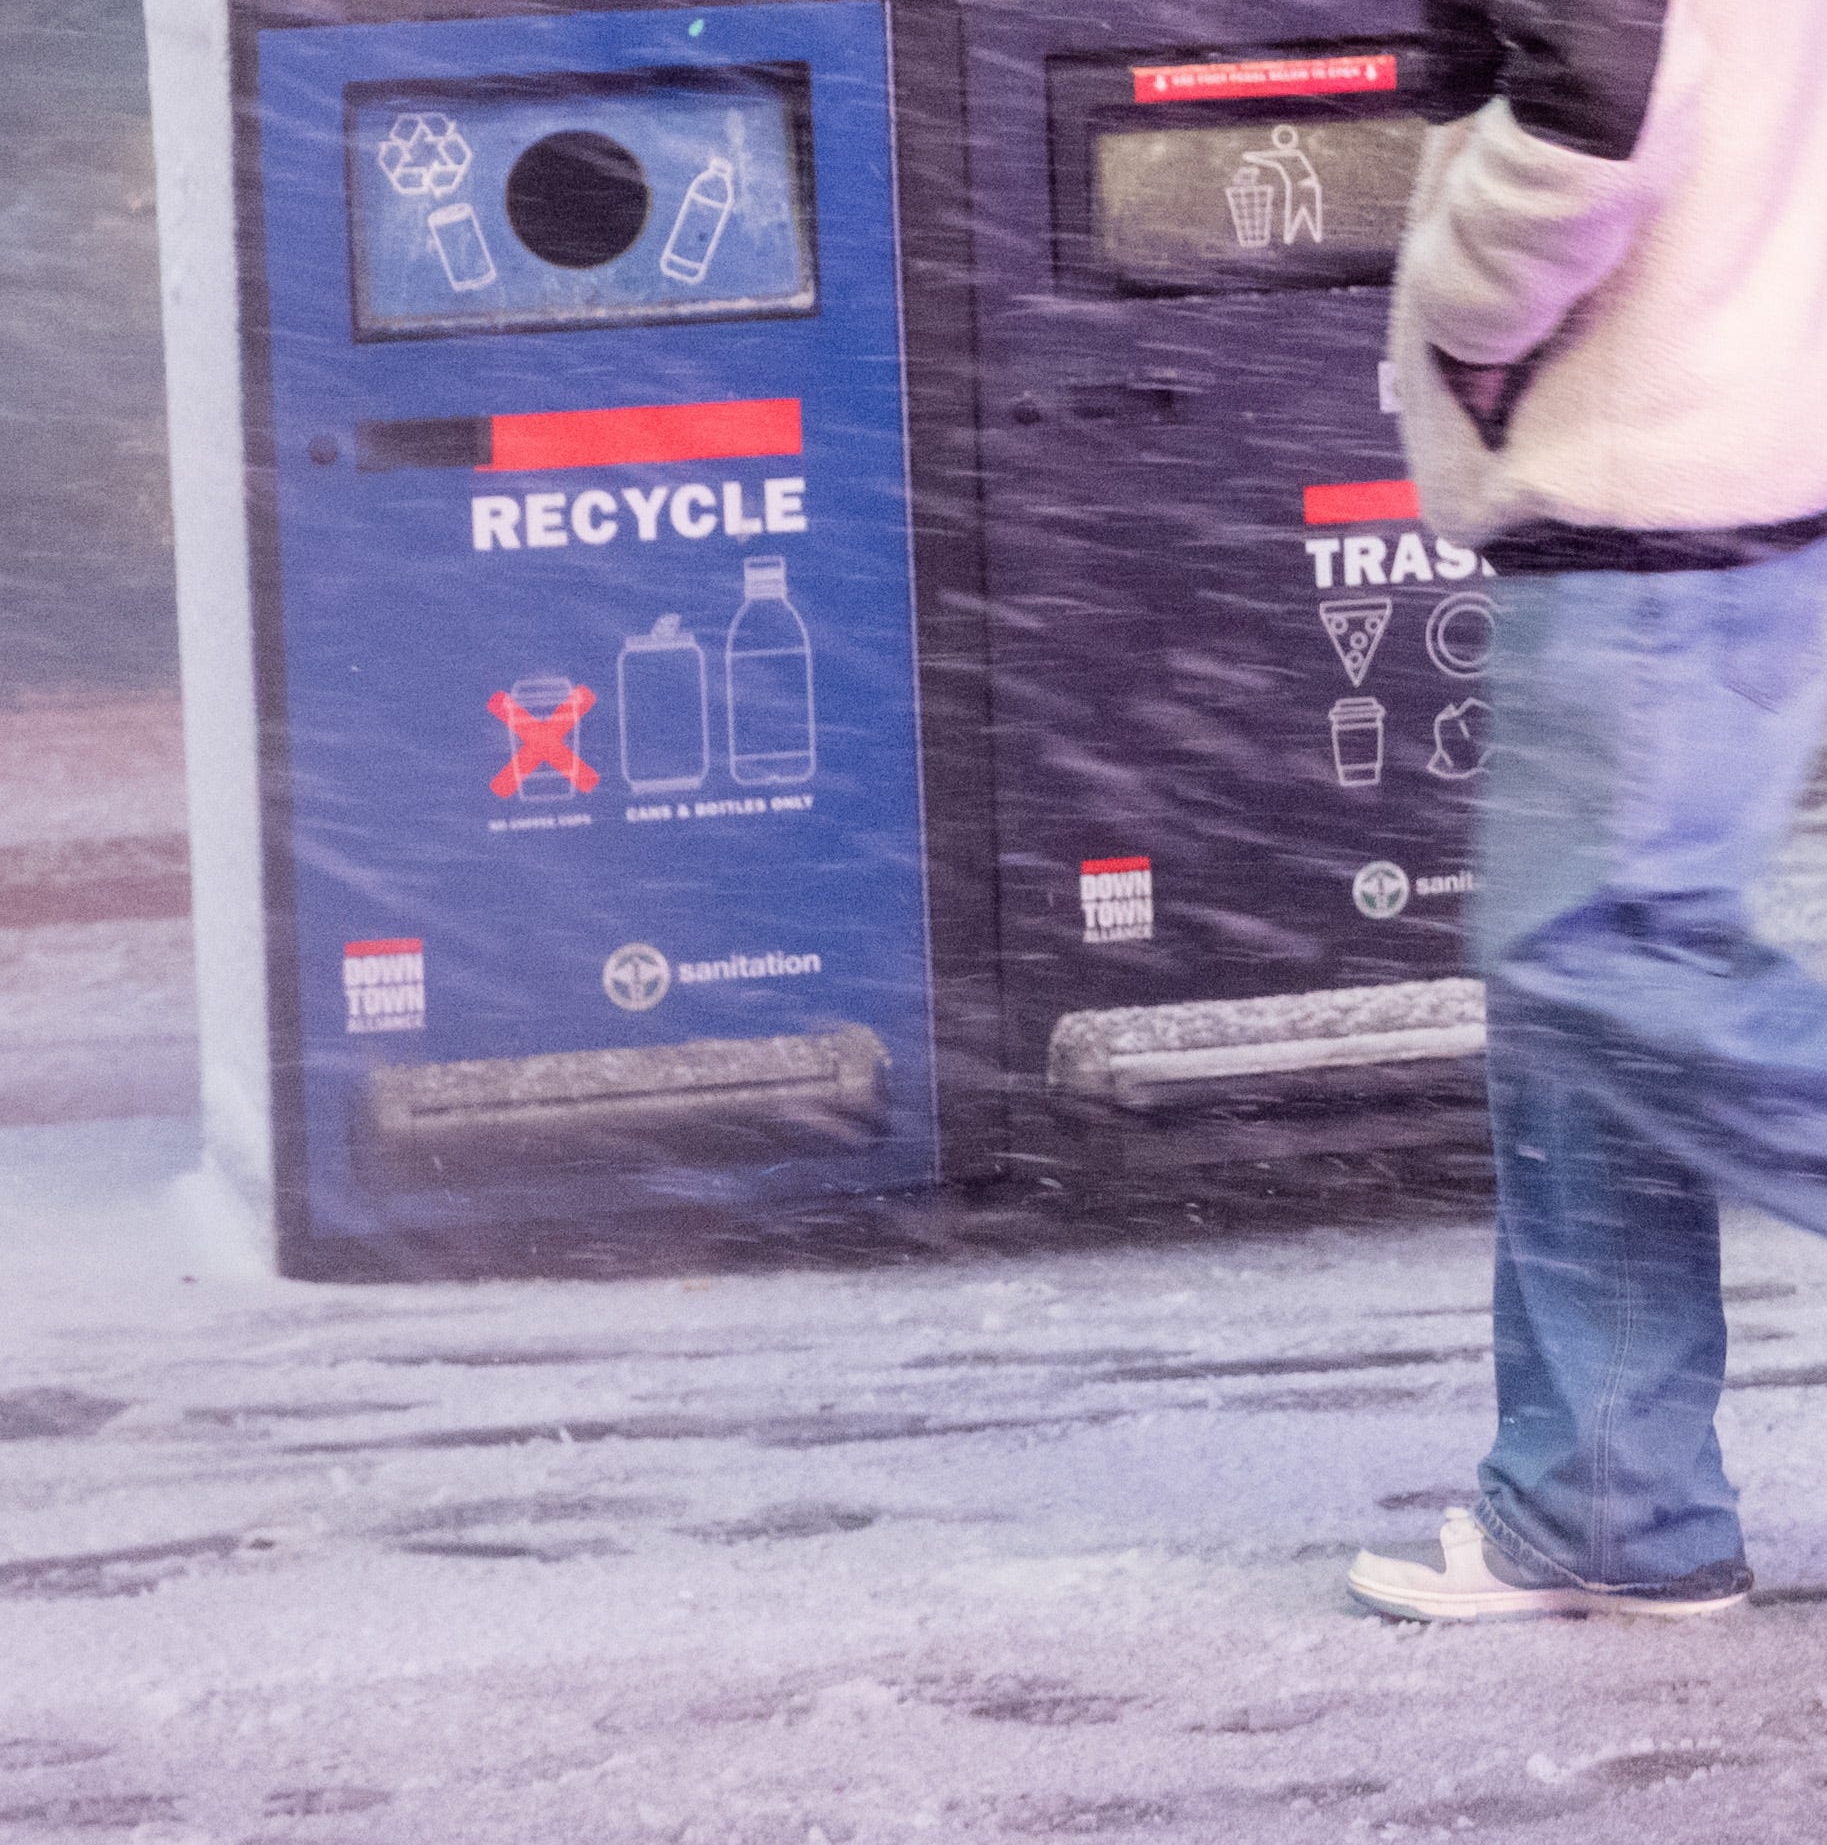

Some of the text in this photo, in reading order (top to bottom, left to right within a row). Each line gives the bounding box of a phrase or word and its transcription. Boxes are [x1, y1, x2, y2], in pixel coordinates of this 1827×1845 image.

[471, 476, 808, 551] RECYCLE
[625, 806, 672, 823] CANS
[694, 797, 767, 818] BOTTLES
[770, 795, 815, 812] ONLY
[1080, 870, 1153, 902] DOWN
[1081, 897, 1154, 929] TOWN
[343, 954, 424, 987] DOWN
[678, 950, 822, 984] sanitation
[345, 984, 425, 1016] TOWN
